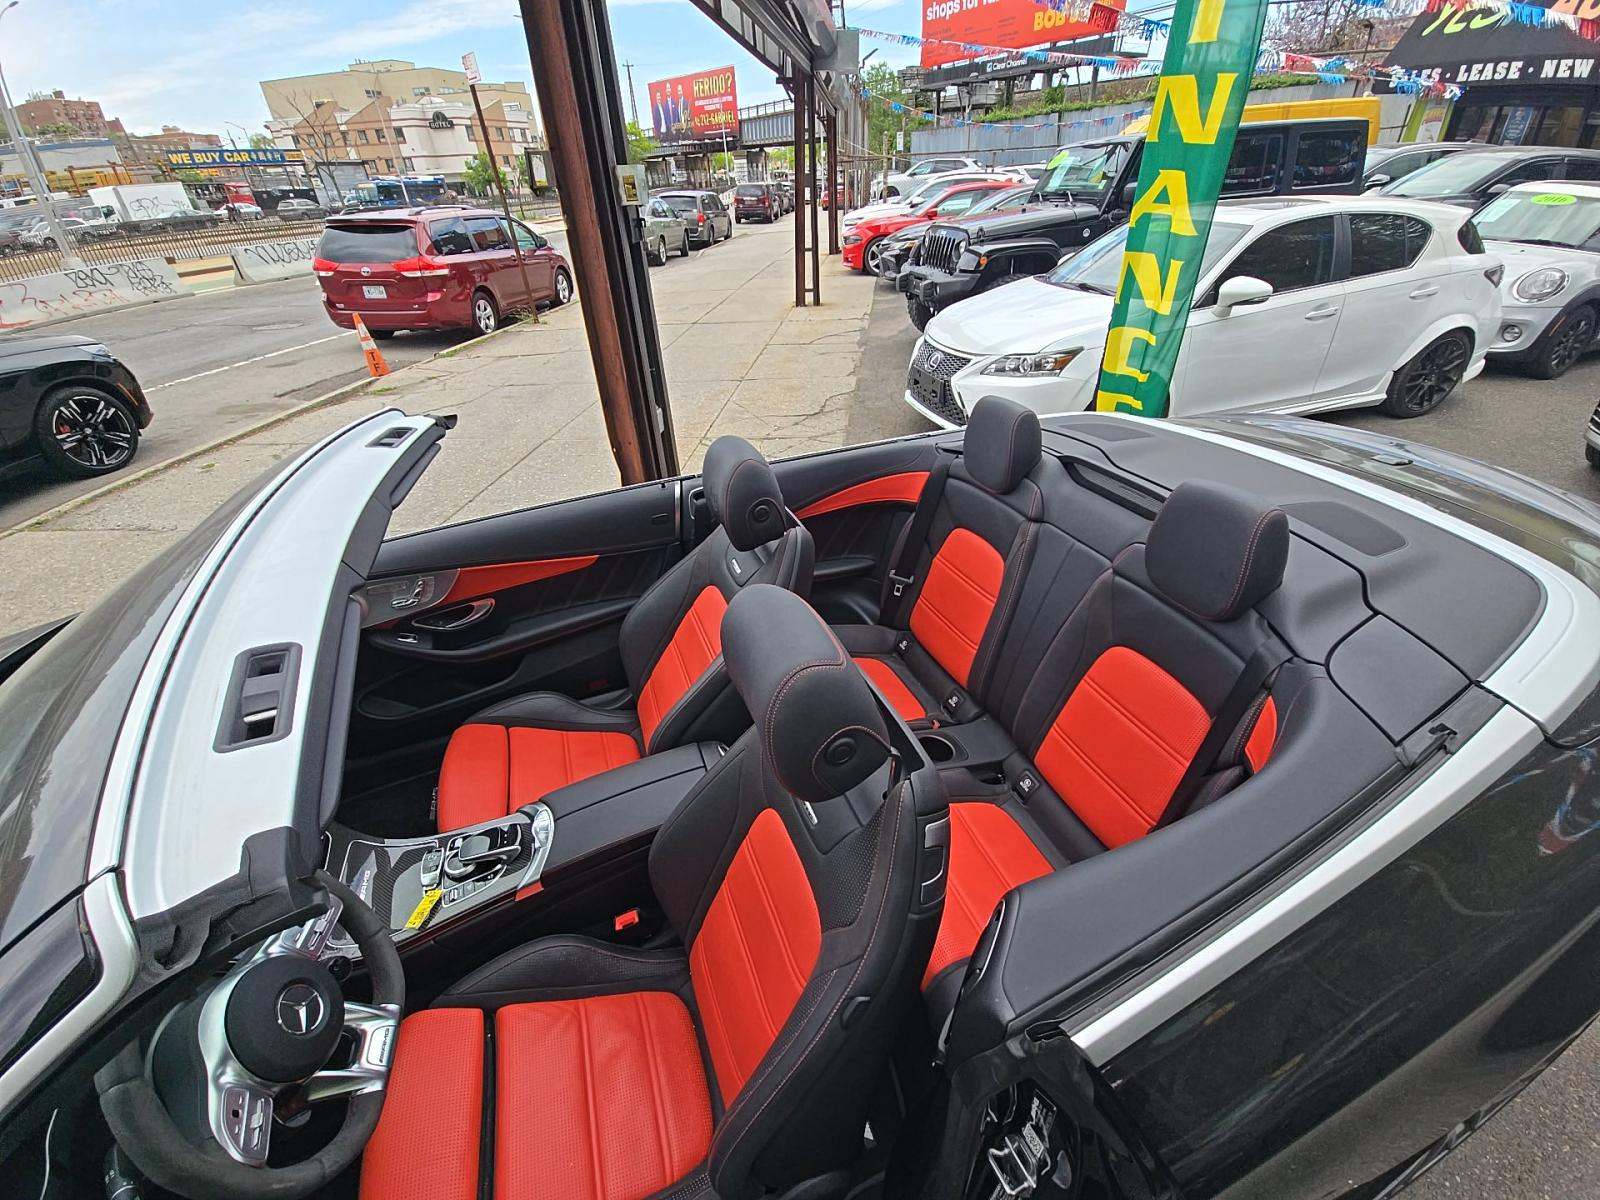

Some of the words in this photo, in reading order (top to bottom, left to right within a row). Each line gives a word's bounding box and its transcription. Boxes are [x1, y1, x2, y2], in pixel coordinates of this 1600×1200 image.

[927, 0, 960, 20] shops
[993, 61, 1006, 70] Clear
[1006, 58, 1027, 68] Channel
[1456, 61, 1523, 82] LEASE
[1540, 59, 1595, 78] NEW
[168, 153, 192, 164] WE
[192, 152, 220, 163] BUY
